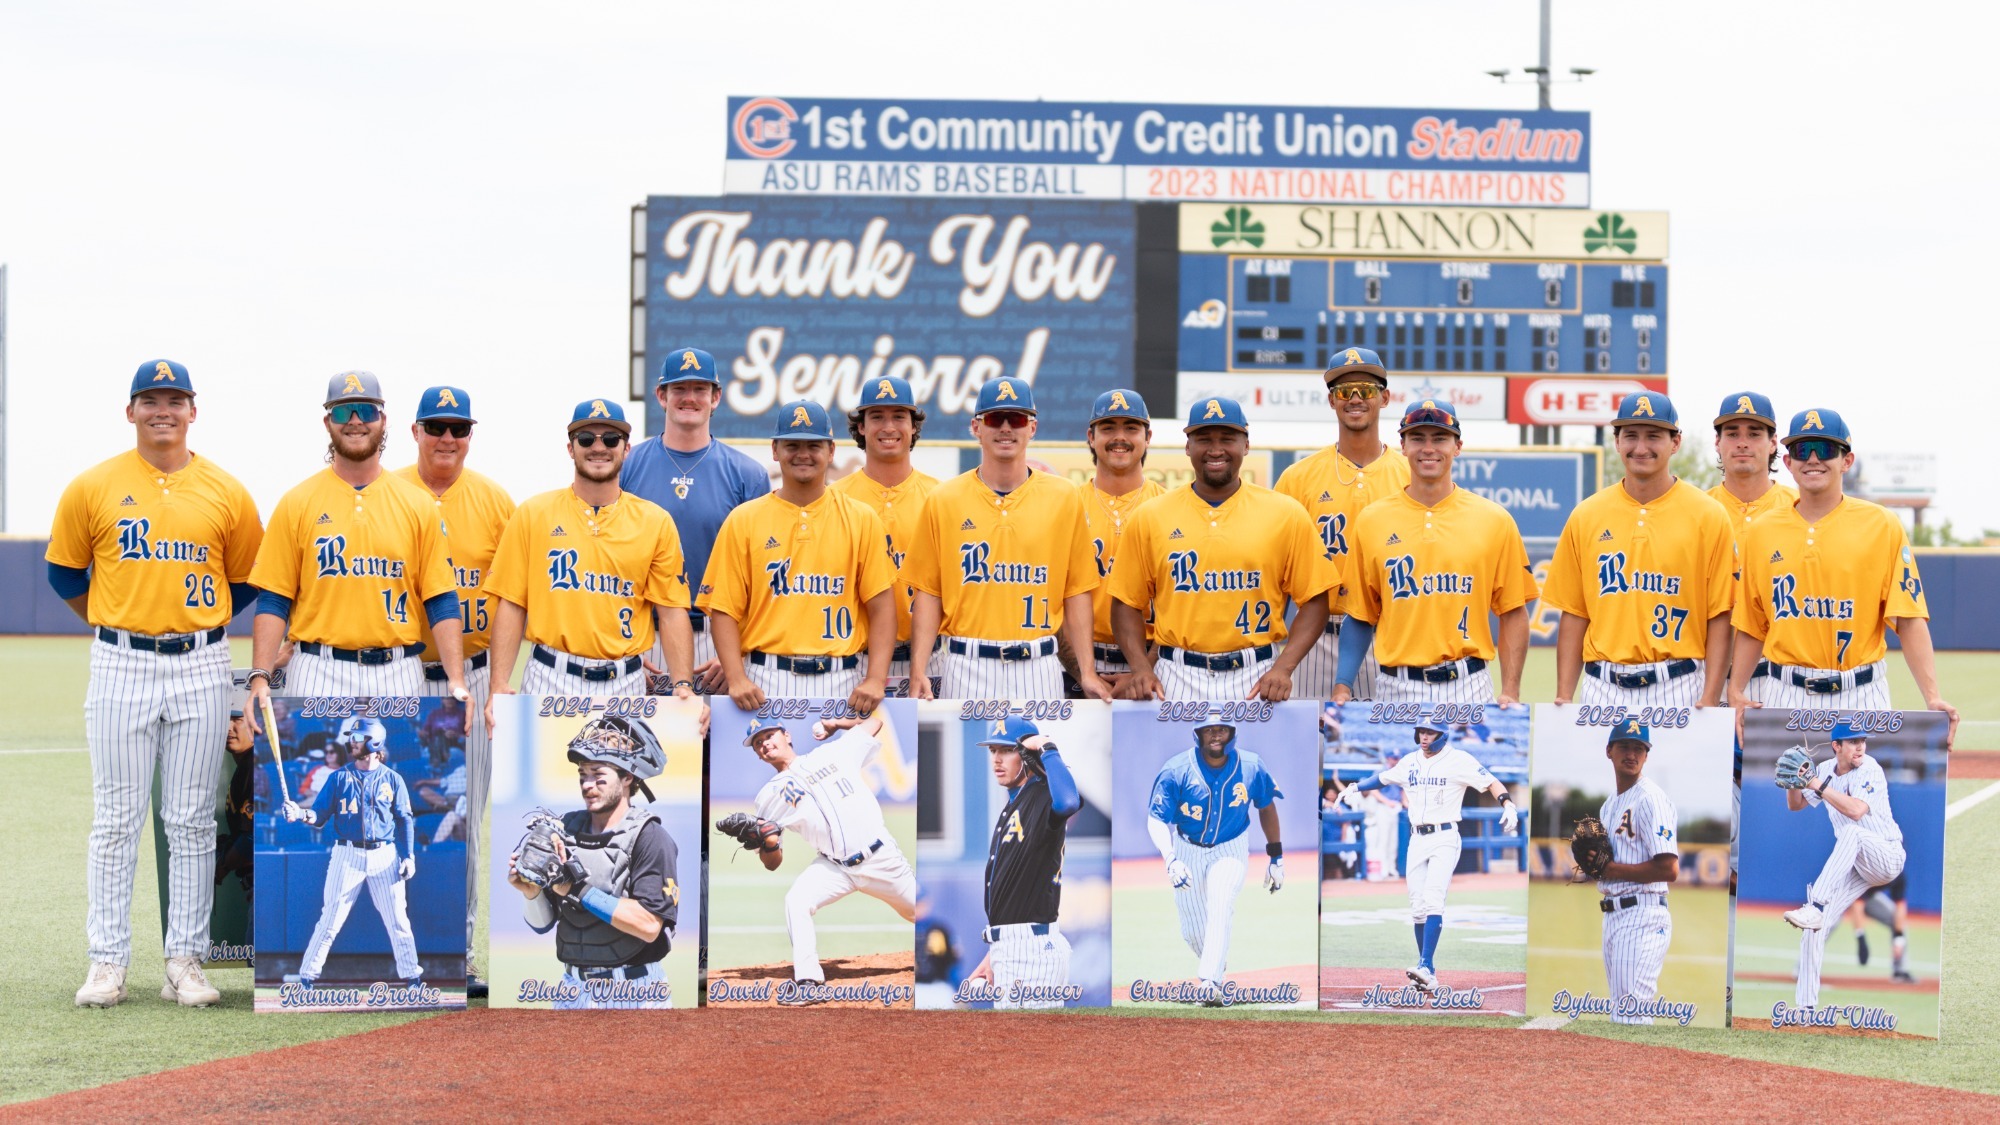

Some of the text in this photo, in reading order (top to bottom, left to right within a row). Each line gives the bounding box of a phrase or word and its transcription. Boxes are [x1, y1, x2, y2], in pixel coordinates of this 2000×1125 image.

[802, 105, 1584, 163] 1st Community Credit Union Stadium
[762, 163, 1086, 195] ASU RAMS BASEBALL
[1147, 167, 1566, 203] 2023 NATIONAL CHAMPIONS
[1296, 205, 1537, 251] SHANNON
[663, 209, 1117, 319] Thank You
[1244, 259, 1293, 276] AT BAT
[1354, 260, 1391, 279] BALL
[1441, 262, 1492, 280] STRIKE
[1537, 263, 1568, 280] OUT
[1528, 314, 1563, 329] RUNS
[725, 326, 1051, 417] Seniors!
[1268, 388, 1329, 407] ULTR
[1451, 459, 1498, 481] CITY
[1466, 487, 1561, 510] TIONAL
[116, 517, 209, 564] Rams
[315, 534, 406, 579] Rams
[959, 540, 1048, 586] Rams
[1168, 549, 1262, 594] Rams
[547, 548, 635, 599] Rams
[1385, 553, 1474, 600] Rams
[184, 573, 216, 609] 26
[381, 588, 409, 624] 14
[1771, 572, 1854, 622] Rams
[460, 598, 489, 634] 15
[618, 607, 634, 640] 3
[821, 605, 853, 640] 10
[1020, 594, 1052, 629] 11
[1235, 600, 1272, 635] 42
[1457, 605, 1470, 640] 4
[1651, 602, 1690, 642] 37
[1836, 631, 1854, 667] 7
[301, 696, 421, 718] 2022-2026
[539, 696, 657, 718] 2024-2026
[958, 698, 1074, 721] 2023-2026
[1156, 699, 1274, 723] 2022-2026
[1368, 703, 1484, 725] 2022-2026
[1575, 704, 1691, 729] 2025-2026
[1785, 708, 1904, 734] 2025-2026
[780, 762, 839, 809] Rams
[833, 777, 855, 800] 10
[1407, 769, 1447, 788] Rams
[339, 798, 359, 815] 14
[1180, 801, 1203, 822] 42
[208, 939, 254, 966] ohnn
[279, 981, 442, 1008] Kannon Brooks
[517, 978, 671, 1002] Blake Wilhoite
[709, 979, 914, 1006] David Dressendorfer
[952, 980, 1084, 1008] Luke Spencer
[1130, 978, 1301, 1006] Christian Garnette
[1361, 982, 1485, 1011] Austin Beck
[1552, 988, 1698, 1027] Dylan Dudney
[1770, 1000, 1898, 1031] Garrett Villa
